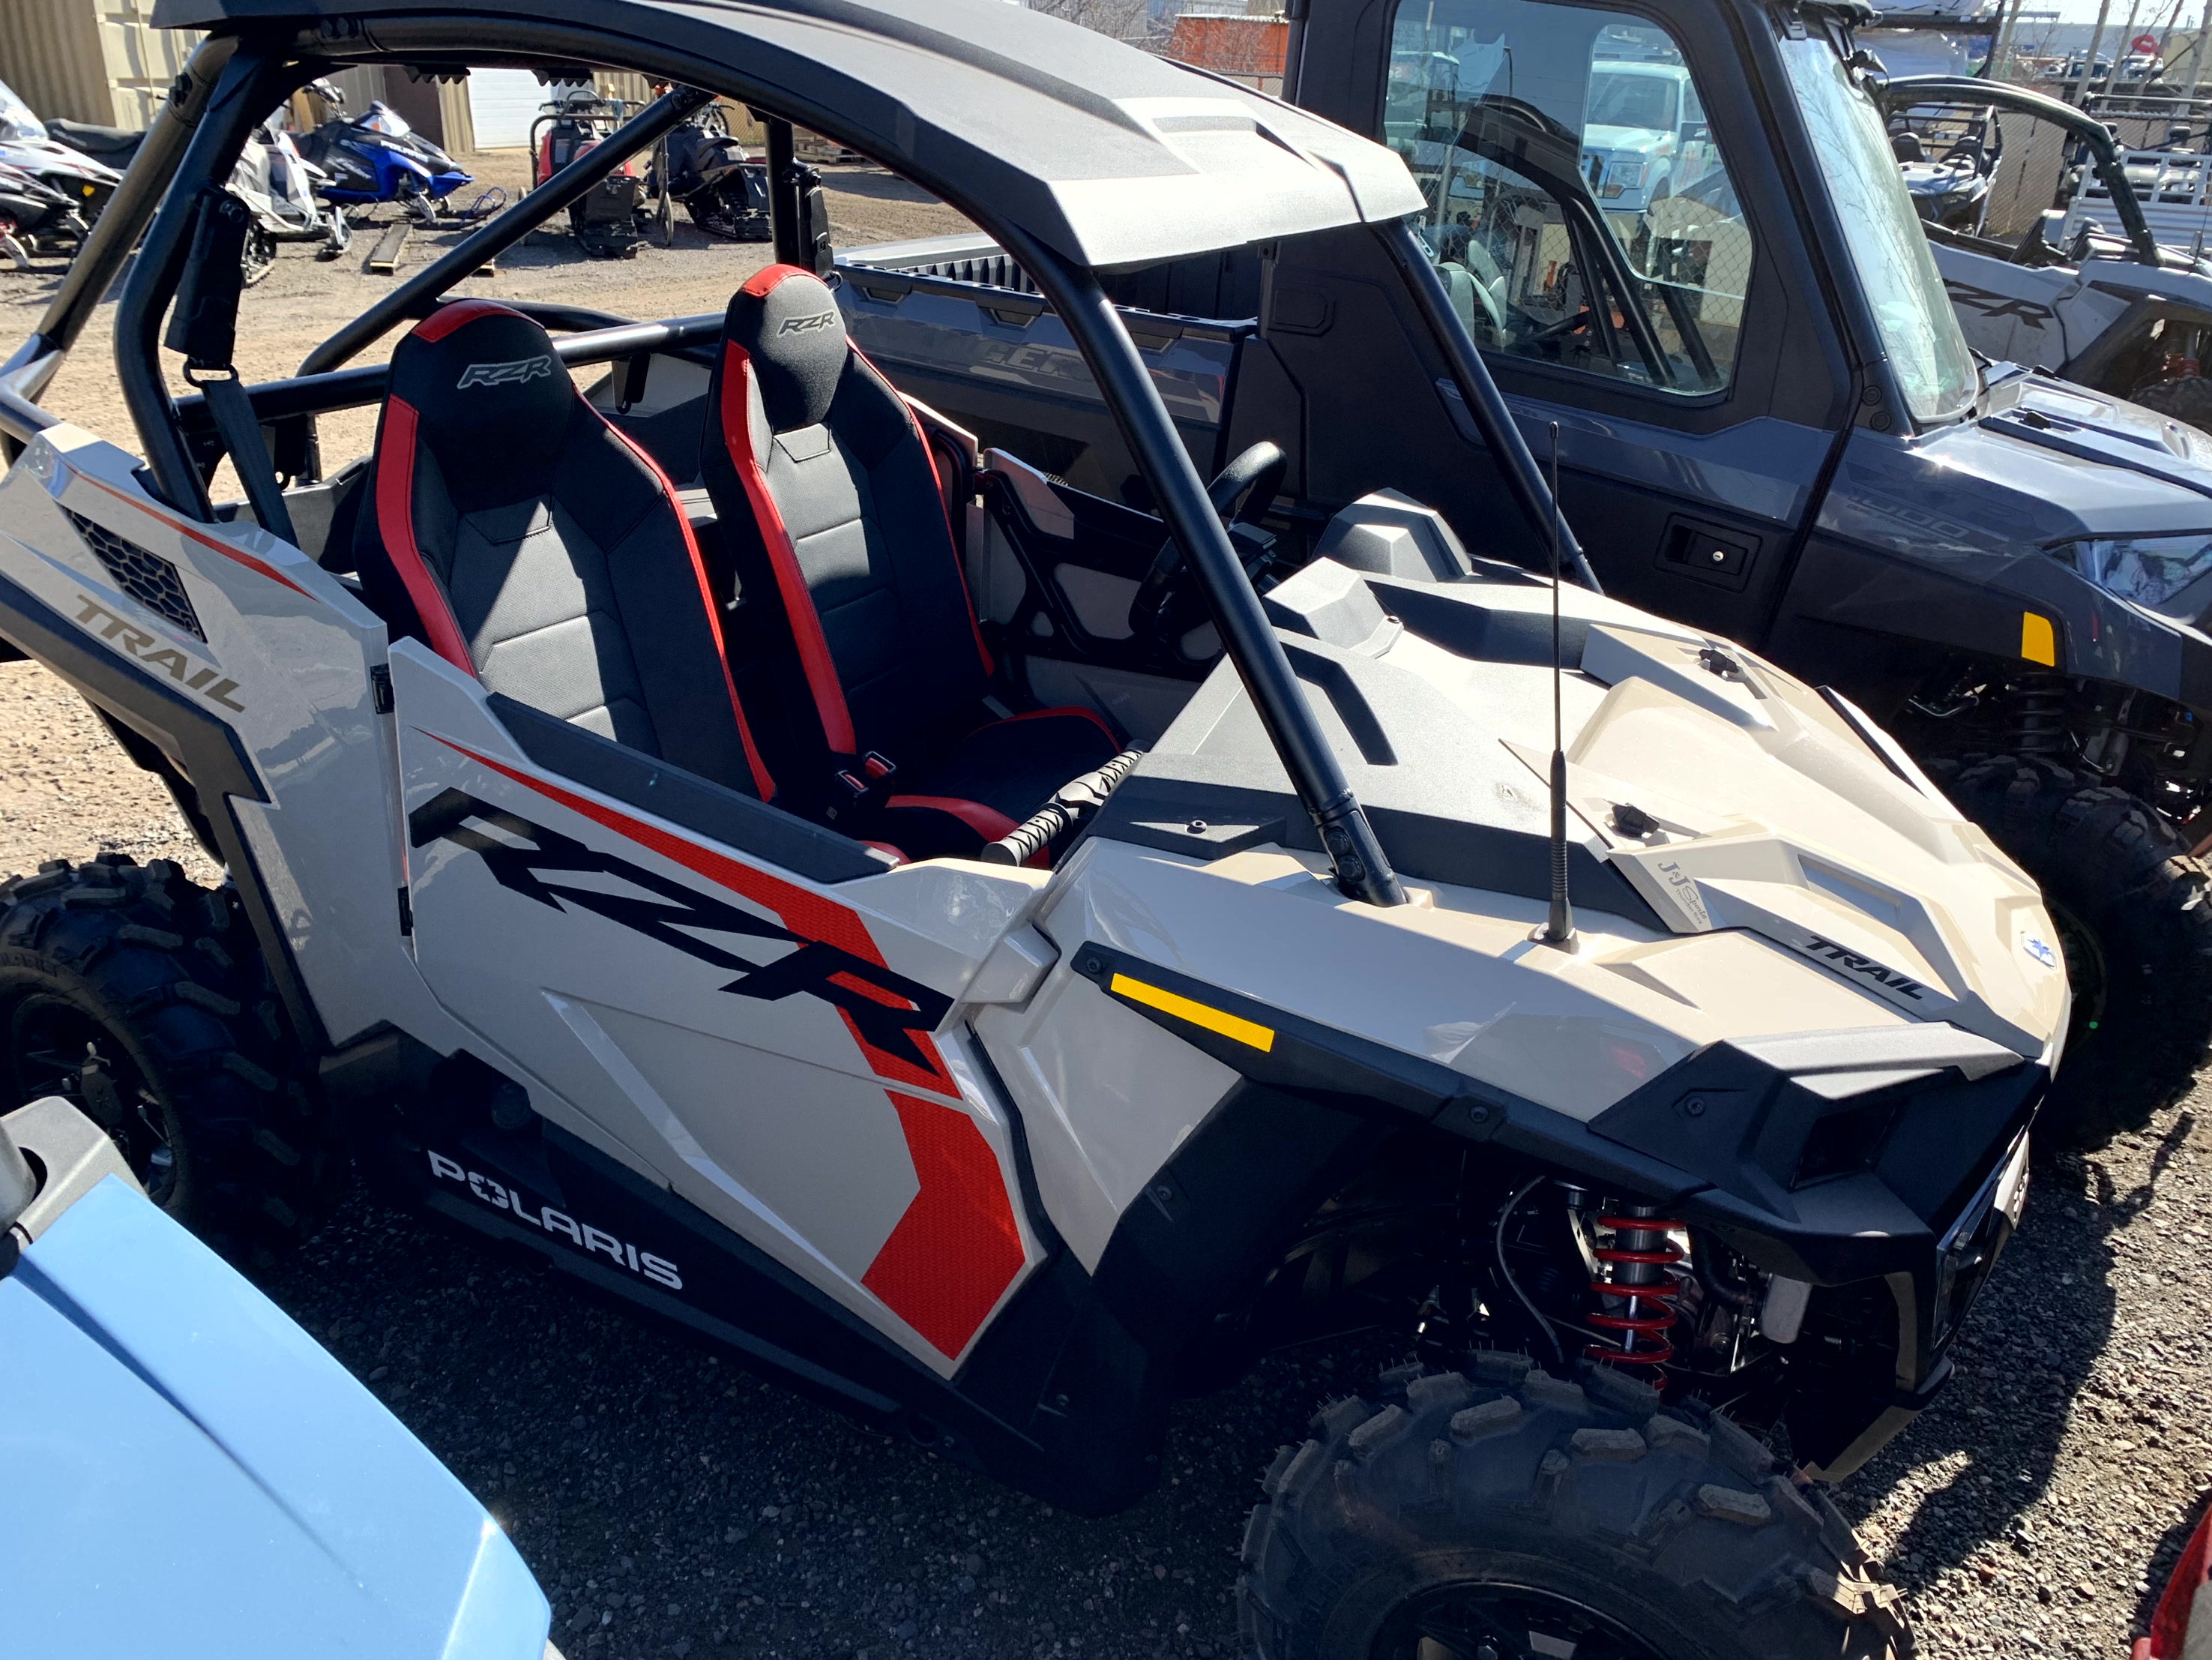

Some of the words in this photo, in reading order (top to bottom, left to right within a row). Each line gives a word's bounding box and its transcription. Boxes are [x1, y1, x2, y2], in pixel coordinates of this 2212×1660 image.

[776, 309, 836, 338] RZR
[1941, 277, 2055, 331] ZR
[456, 354, 552, 389] RZR
[76, 594, 246, 713] TRAIL
[1657, 861, 1692, 886] J&J
[1682, 885, 1708, 920] Sports
[1675, 888, 1694, 912] Thunder
[1693, 911, 1703, 924] Bay
[409, 787, 956, 1079] RZR
[1805, 935, 1923, 1000] TRAIL
[427, 1149, 683, 1290] POLARIS
